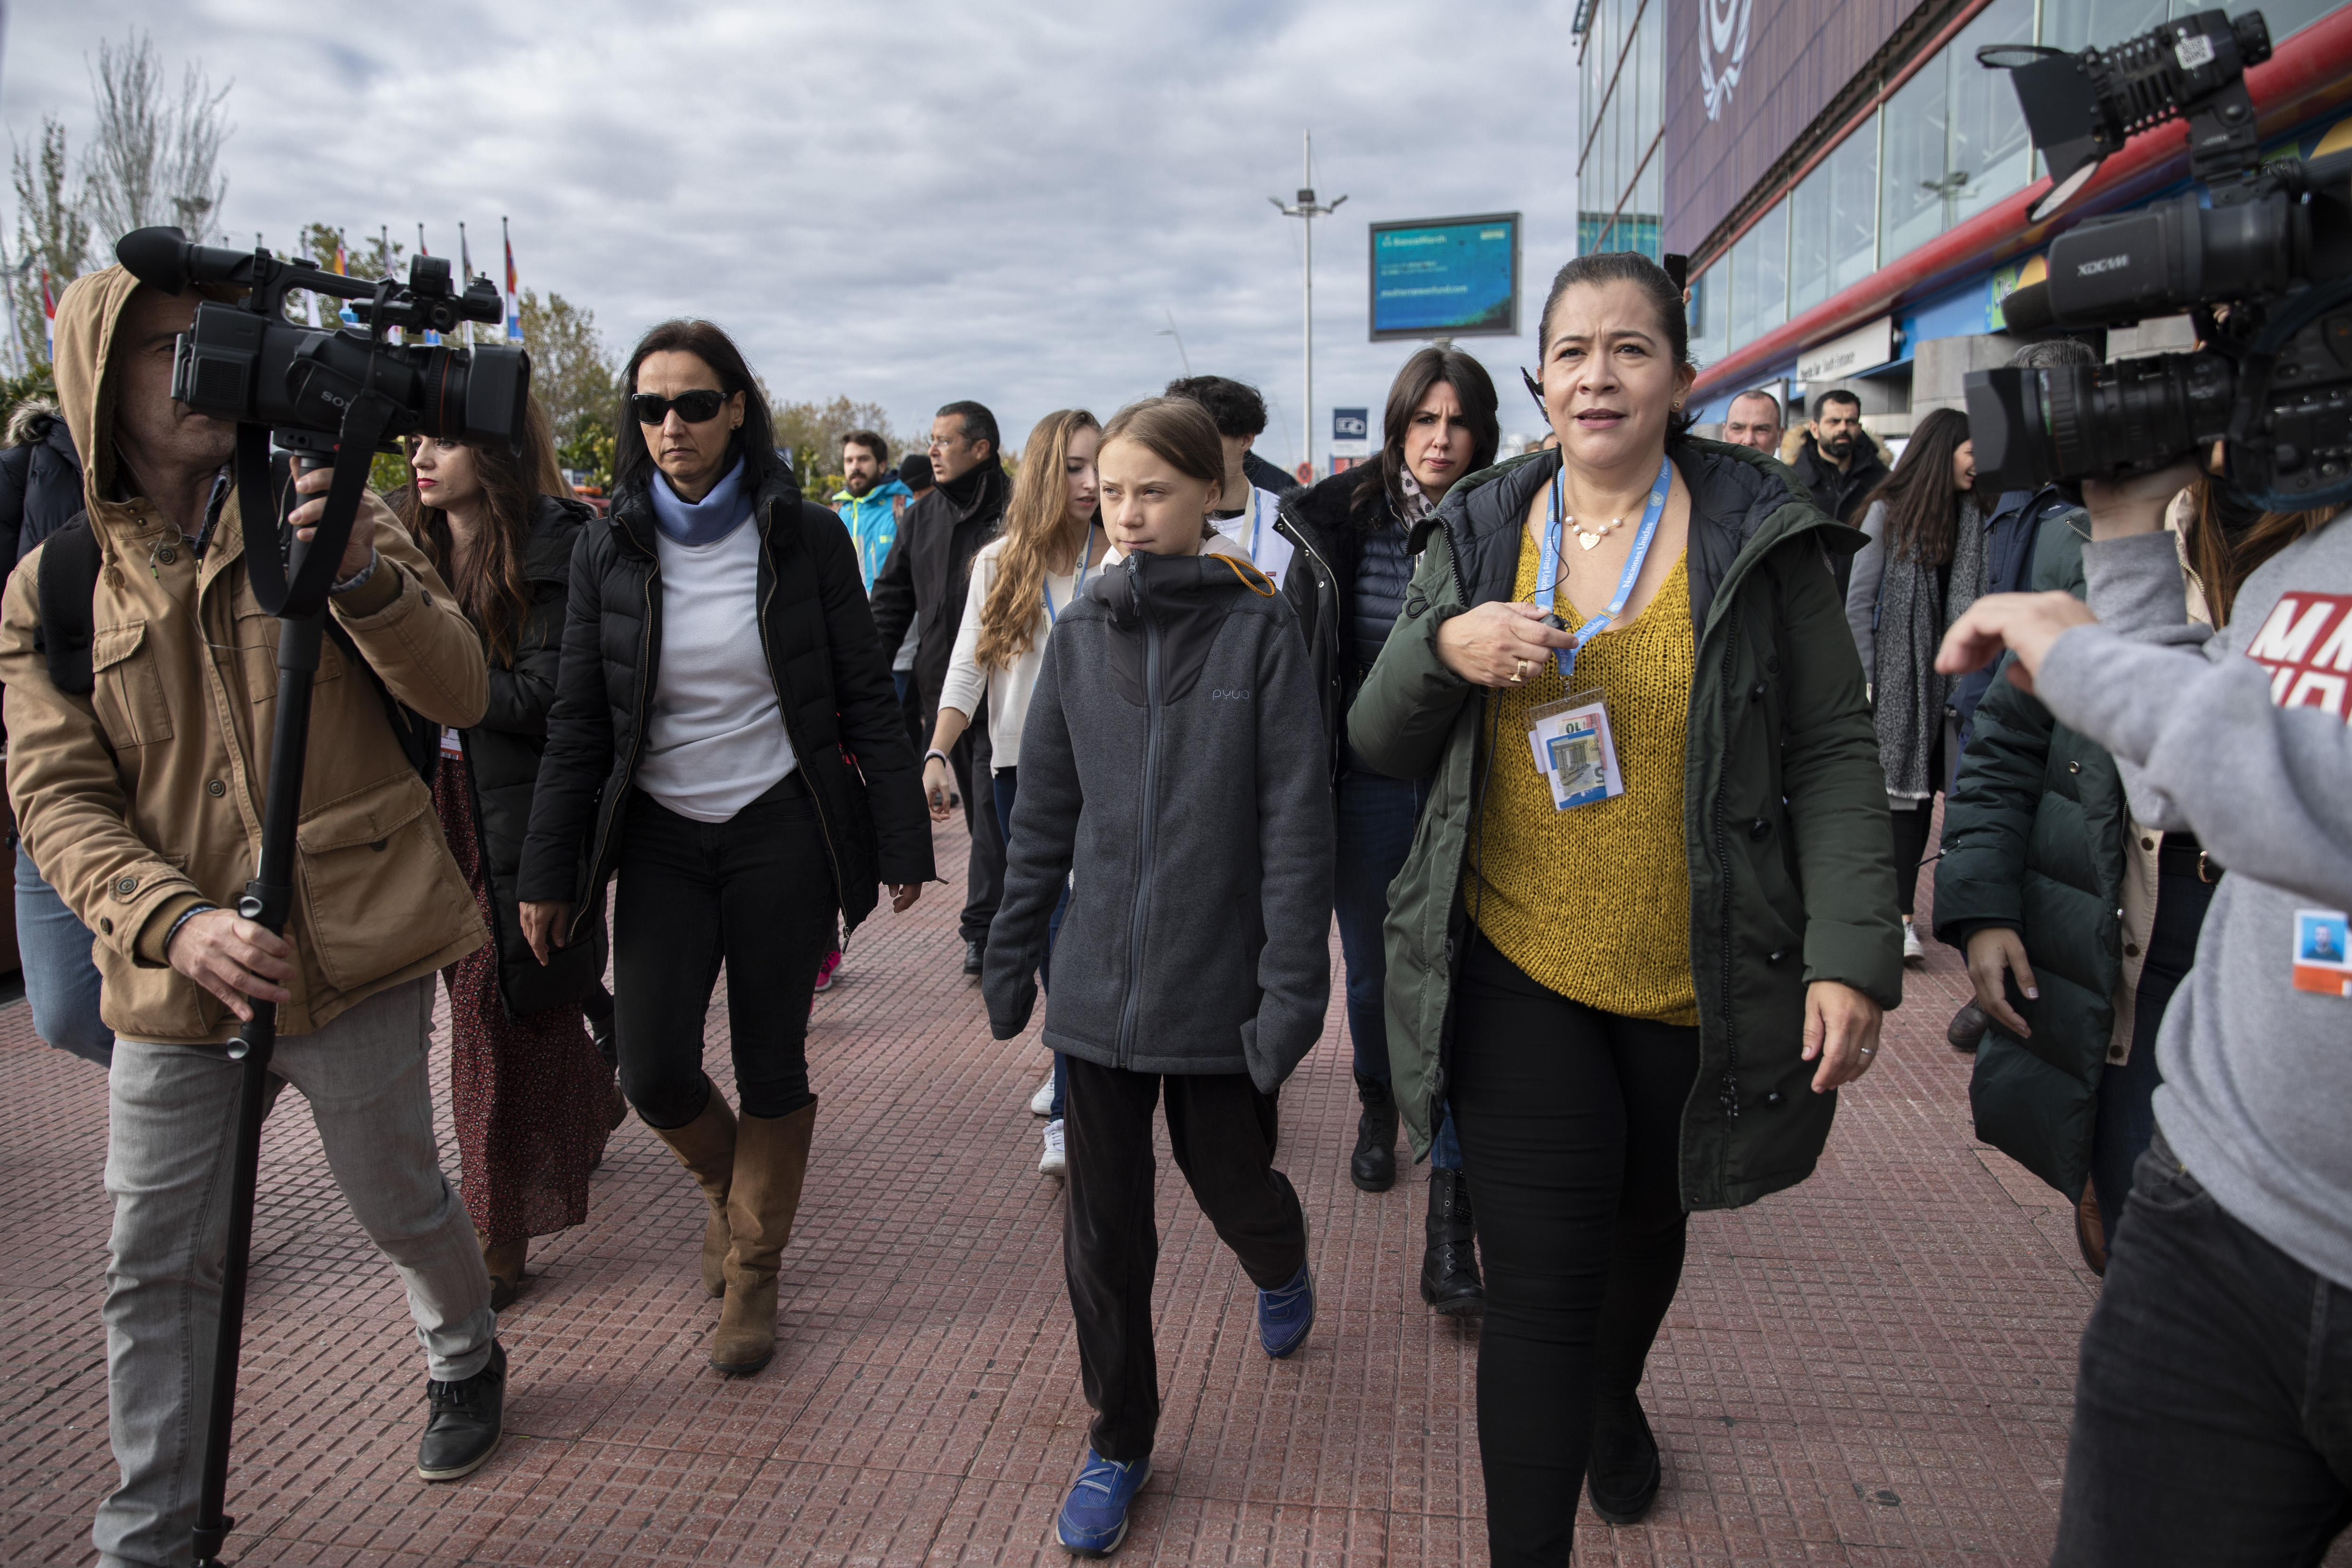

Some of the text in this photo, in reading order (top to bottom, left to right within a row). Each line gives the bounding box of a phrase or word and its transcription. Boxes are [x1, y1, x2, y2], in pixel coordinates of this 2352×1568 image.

[2077, 254, 2129, 277] XDCAM
[1822, 354, 1834, 374] South
[1835, 350, 1856, 369] Entrance
[1540, 536, 1556, 594] Naciones Unidas
[1622, 522, 1653, 588] Naciones Unidas
[1581, 619, 1605, 635] Unidas
[1566, 722, 1581, 734] 10
[1594, 766, 1605, 784] 5
